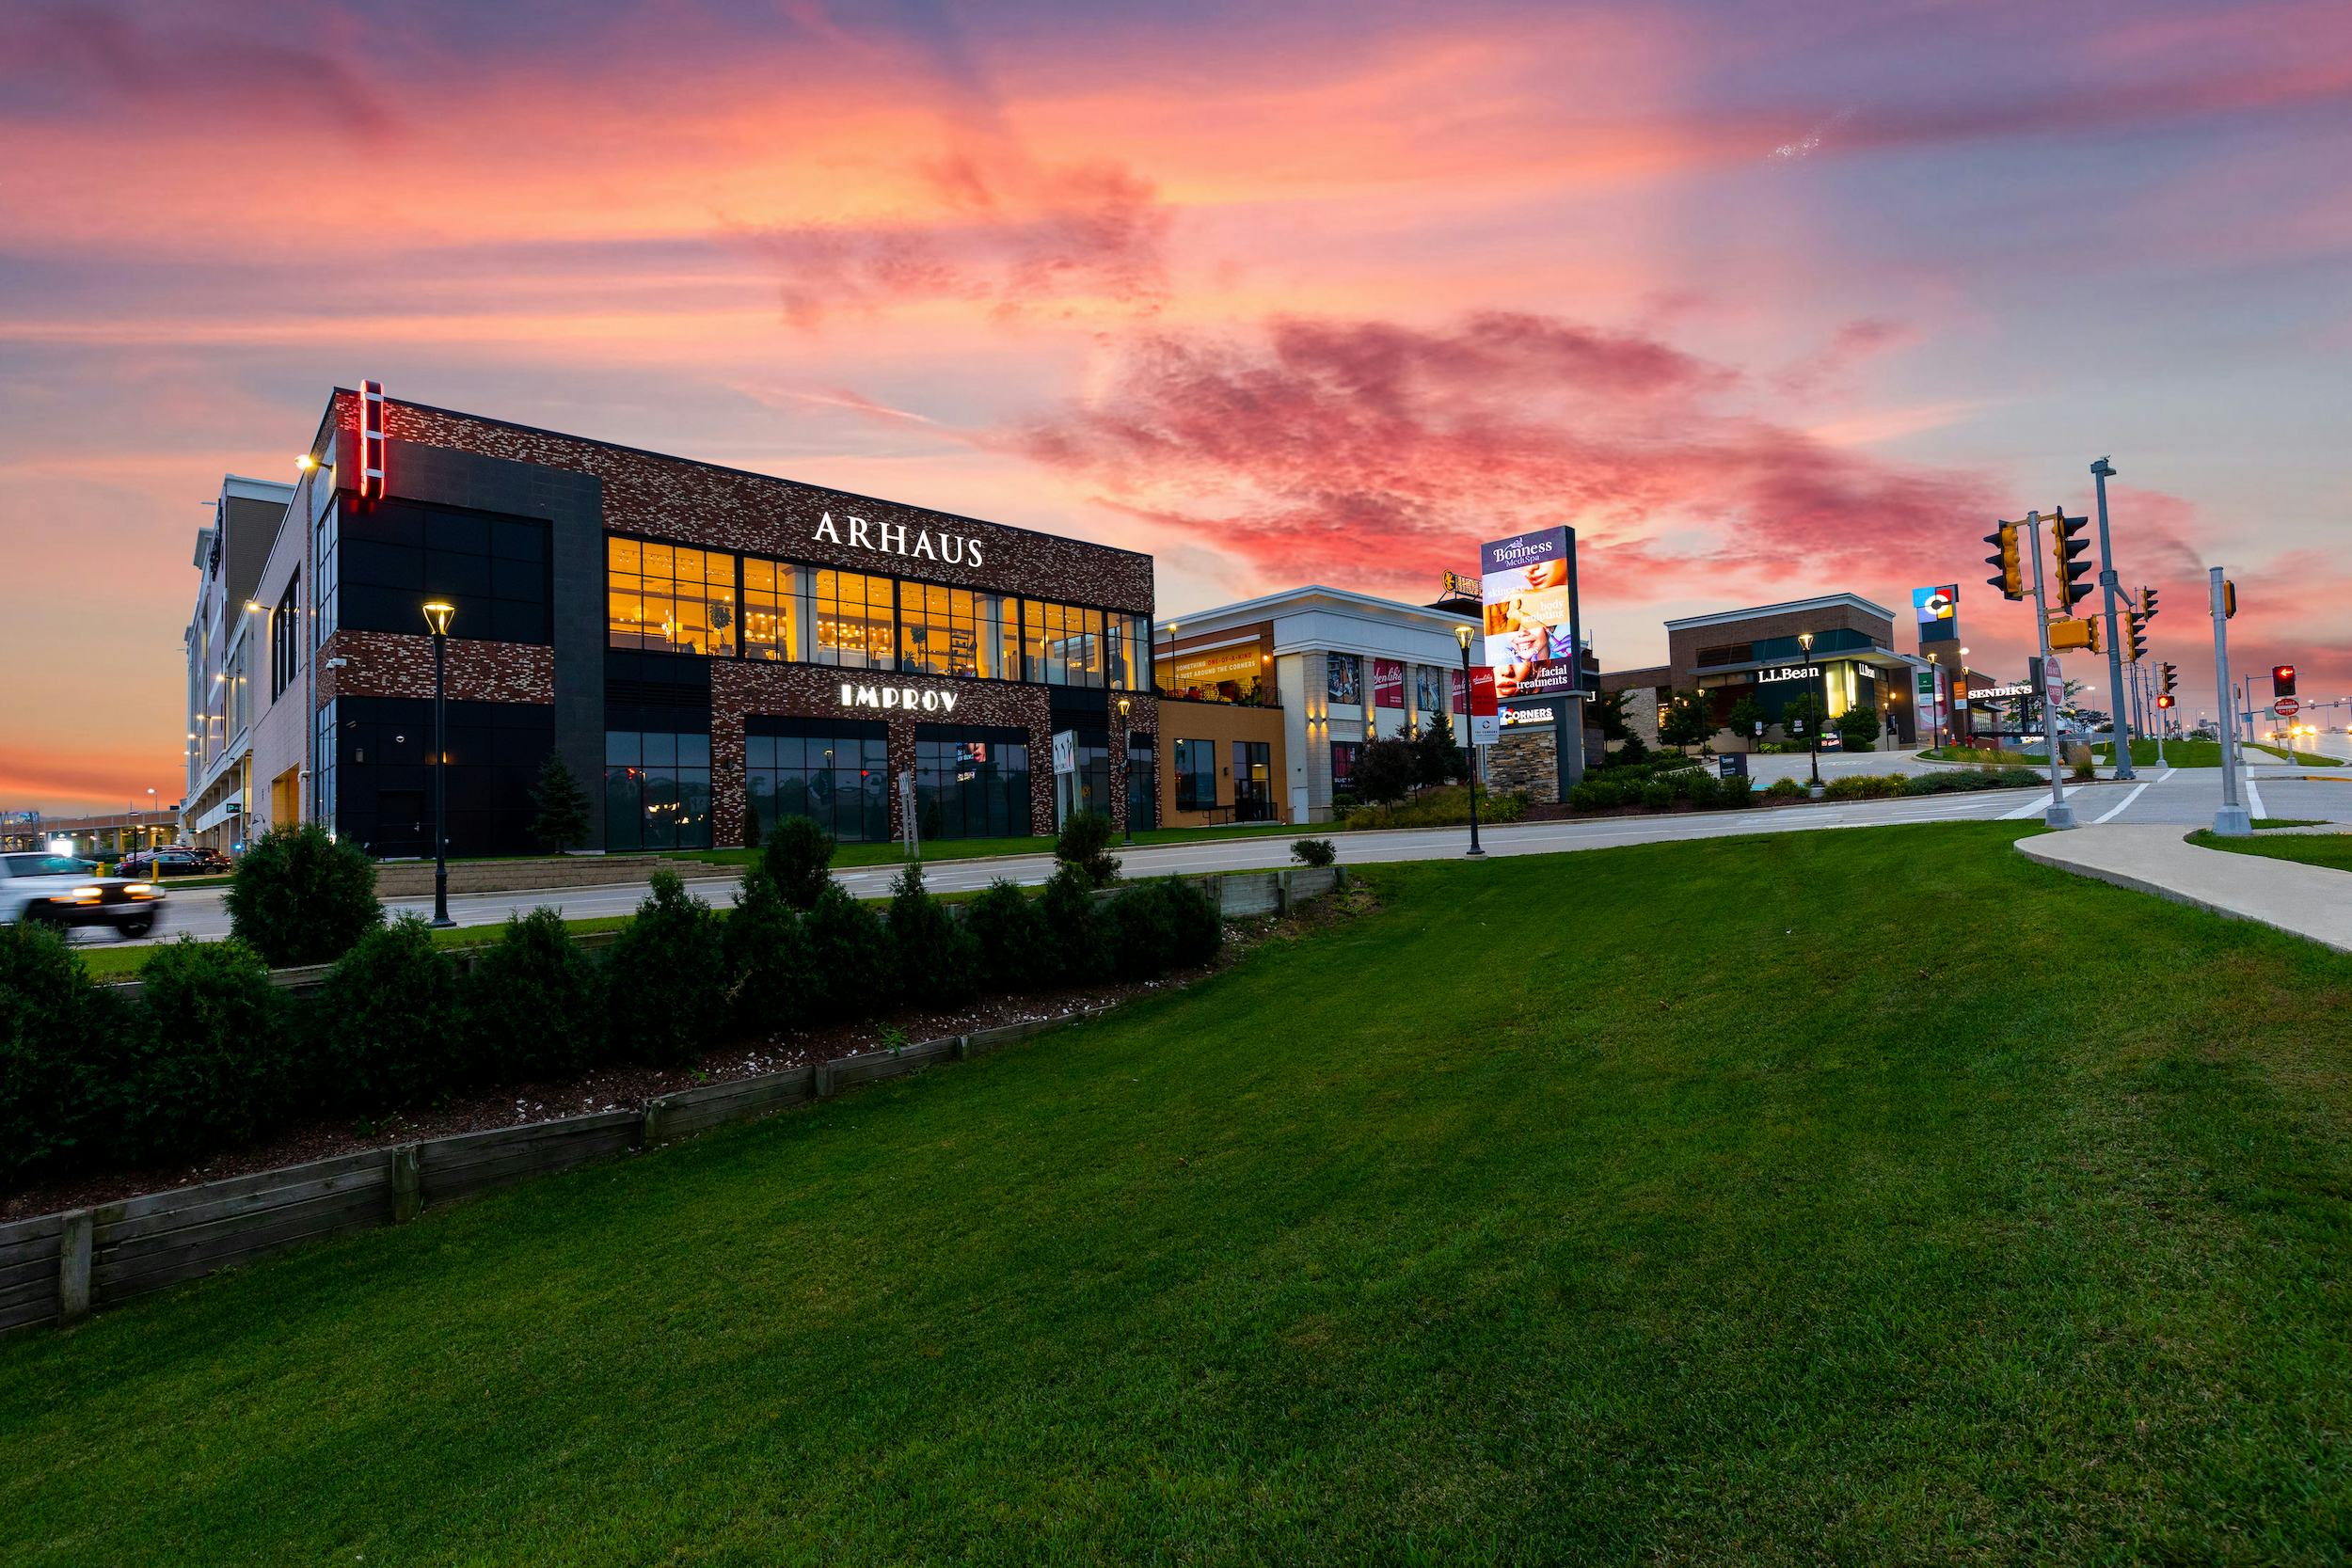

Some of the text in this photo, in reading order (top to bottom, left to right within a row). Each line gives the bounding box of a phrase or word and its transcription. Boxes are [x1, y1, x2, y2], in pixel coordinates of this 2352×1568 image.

[811, 511, 983, 567] ARHAUS
[1493, 541, 1552, 562] Bonness
[1505, 555, 1540, 567] MediSpa
[1540, 599, 1564, 610] body
[1176, 661, 1206, 672] SOMETHING
[1194, 668, 1216, 677] AROUND
[1229, 660, 1256, 671] CORNERS
[1541, 664, 1567, 677] facial
[1516, 675, 1568, 689] treatments
[1758, 667, 1820, 683] L.L.Bean
[841, 684, 958, 712] IMPROV
[1968, 686, 2032, 699] SENDIK'S
[2049, 688, 2060, 696] ENTER
[1502, 707, 1552, 721] CORNERS
